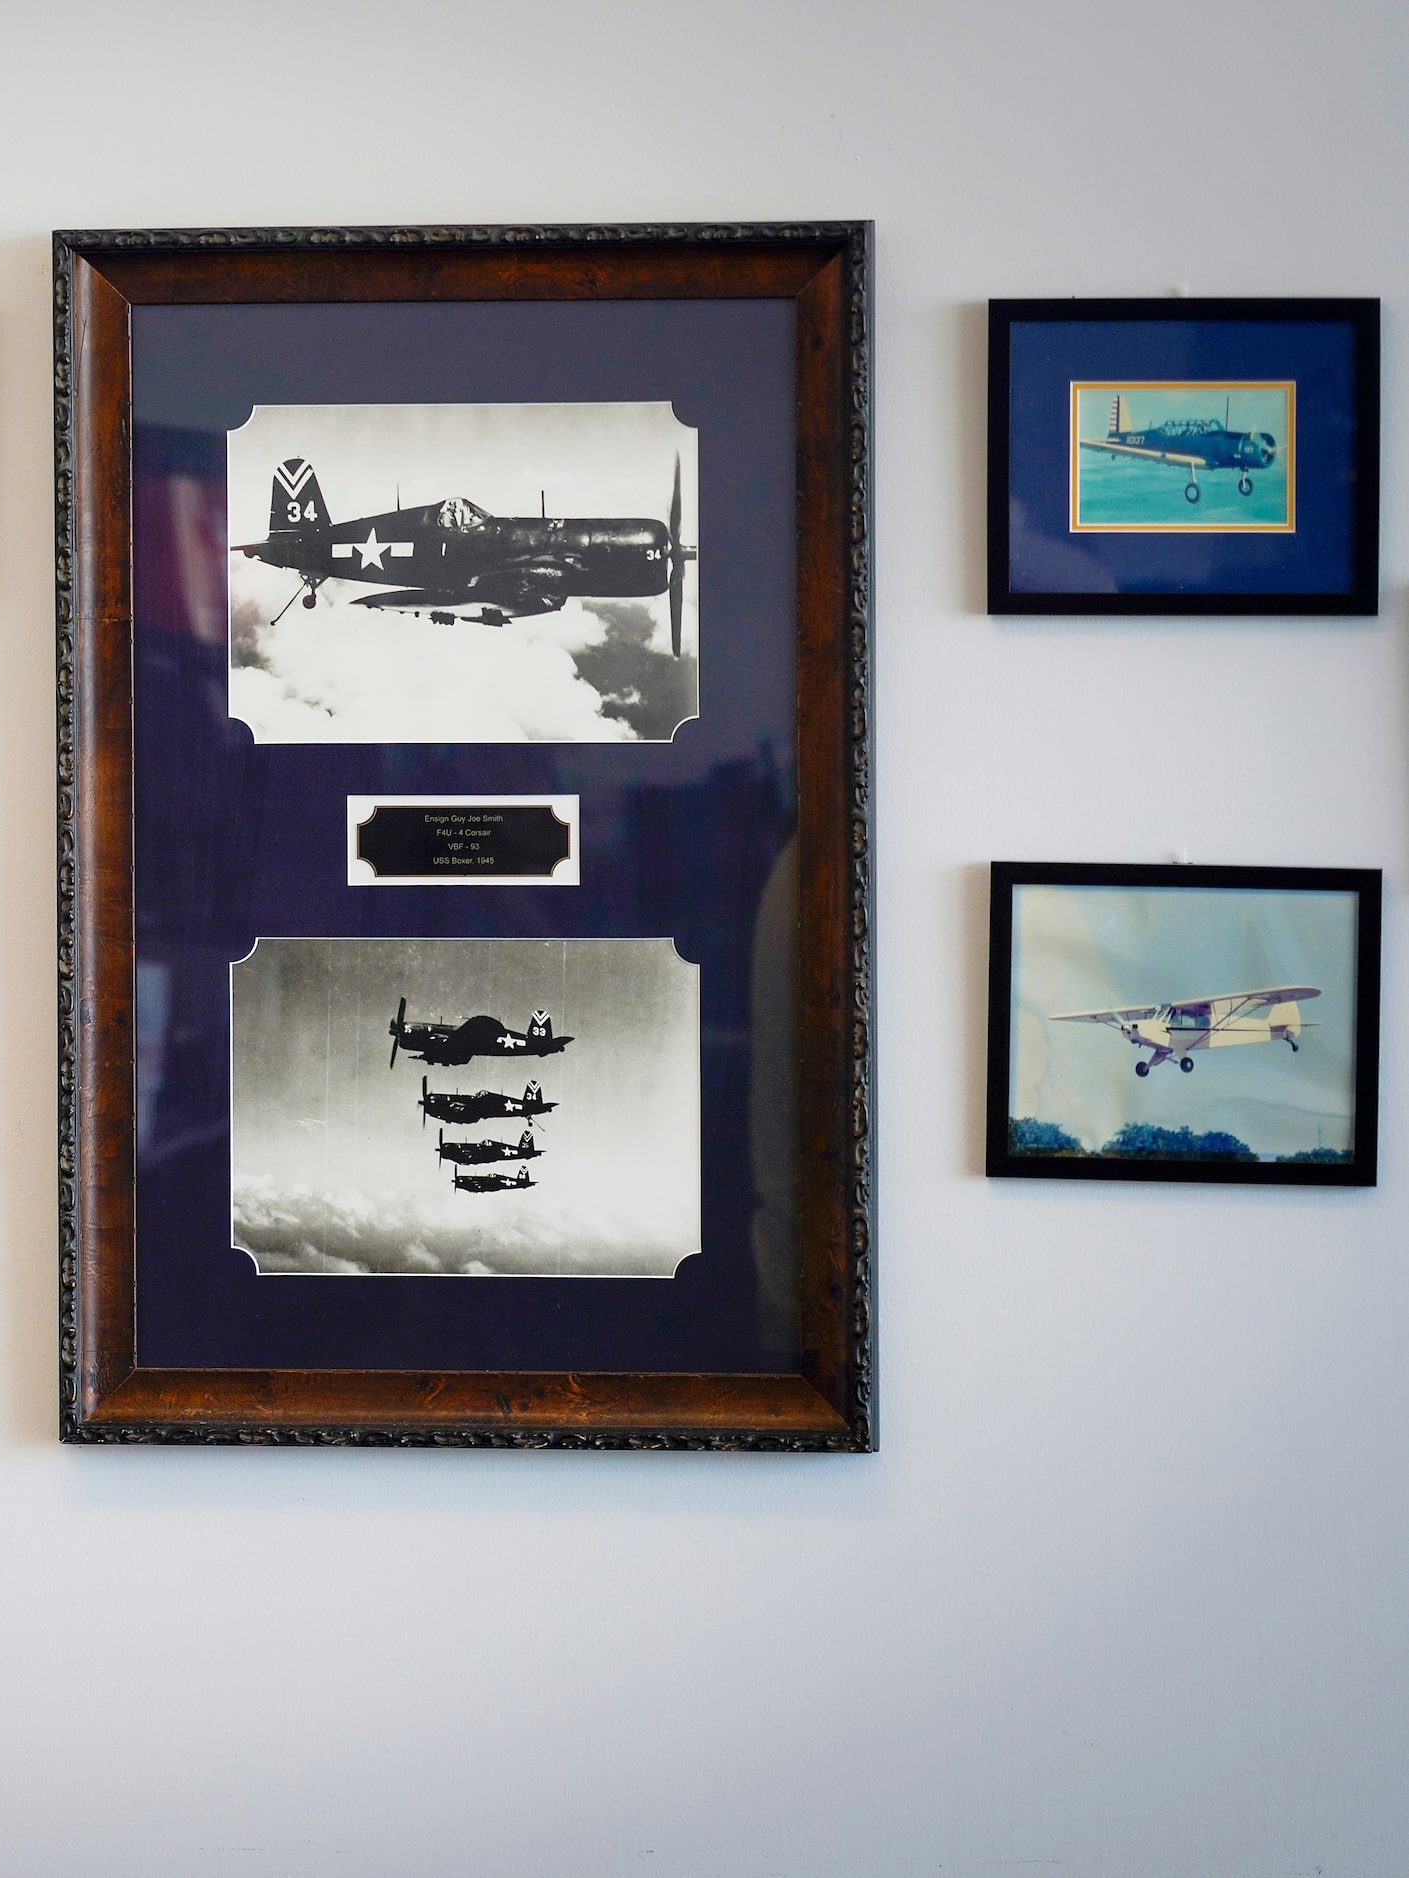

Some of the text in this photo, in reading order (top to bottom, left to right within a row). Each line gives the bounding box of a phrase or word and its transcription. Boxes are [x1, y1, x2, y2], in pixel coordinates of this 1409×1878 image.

[287, 500, 318, 523] 34
[646, 548, 662, 561] 34
[424, 814, 504, 824] Ensign Guy Joe Smith
[436, 828, 452, 836] F4U
[458, 828, 463, 836] 4
[464, 828, 492, 836] Corsair
[447, 842, 464, 851] VBF
[470, 842, 480, 851] 93
[433, 856, 450, 865] USS
[477, 856, 495, 865] 1945
[532, 1026, 547, 1037] 33
[526, 1092, 538, 1101] 34
